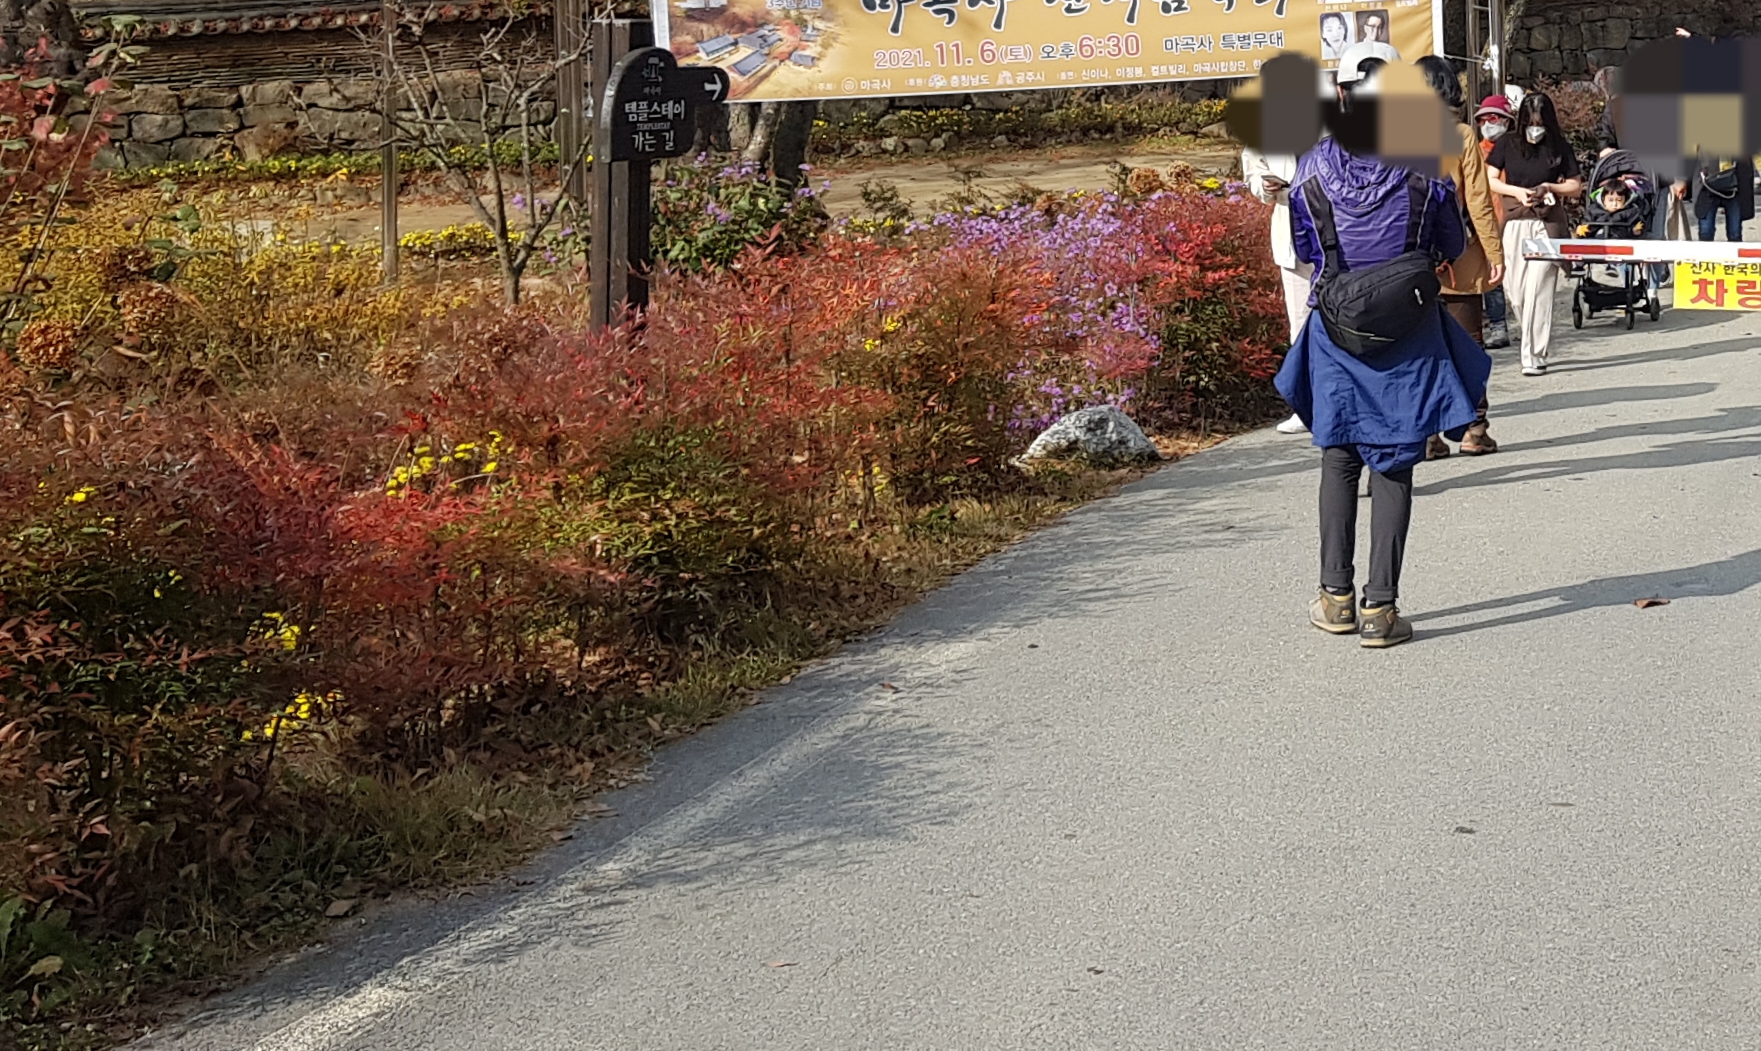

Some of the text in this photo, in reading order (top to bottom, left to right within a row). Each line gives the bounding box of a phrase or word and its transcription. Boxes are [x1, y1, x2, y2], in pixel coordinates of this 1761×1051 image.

[1164, 36, 1213, 54] 마곡사
[1220, 31, 1284, 51] 특별무대
[860, 78, 891, 91] 마곡사
[1016, 71, 1045, 84] 공주시
[624, 99, 685, 122] 템플스테이
[631, 130, 675, 152] 가는 길
